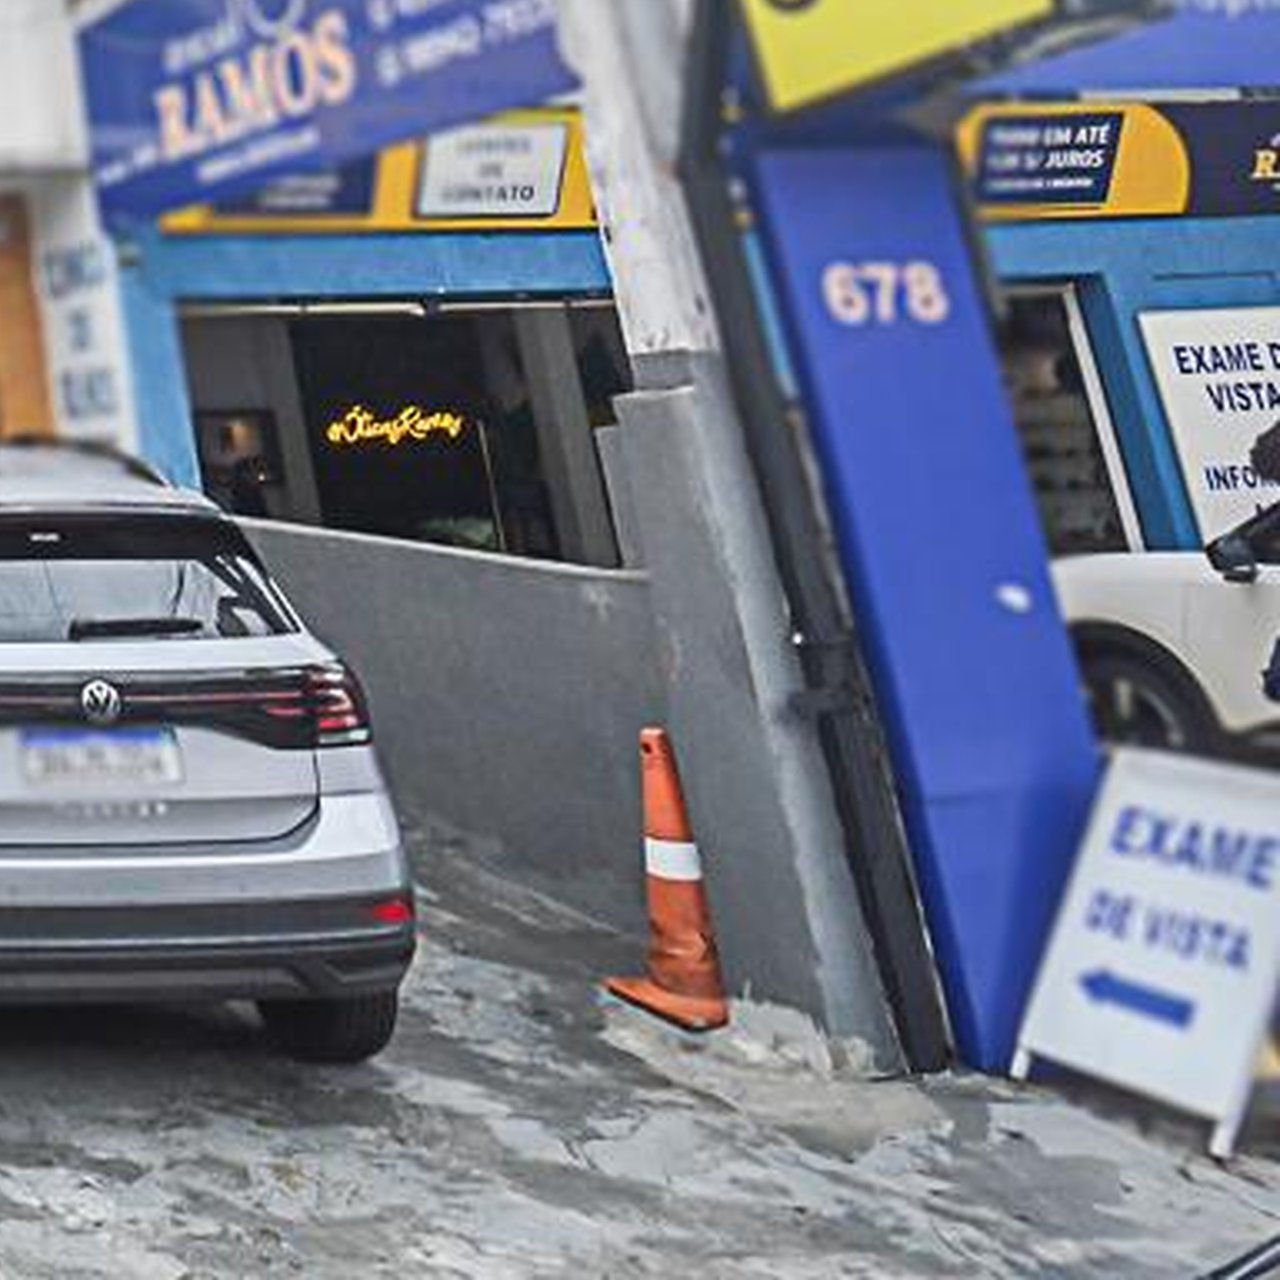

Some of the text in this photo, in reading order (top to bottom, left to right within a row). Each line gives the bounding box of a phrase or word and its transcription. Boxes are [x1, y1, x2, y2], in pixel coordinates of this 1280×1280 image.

[154, 10, 355, 161] RAMOS
[1250, 149, 1280, 179] R
[822, 260, 949, 325] 678
[1173, 342, 1264, 374] EXAME
[1206, 382, 1280, 412] VISTA
[1204, 465, 1272, 491] INFO
[1110, 805, 1277, 890] EXAME
